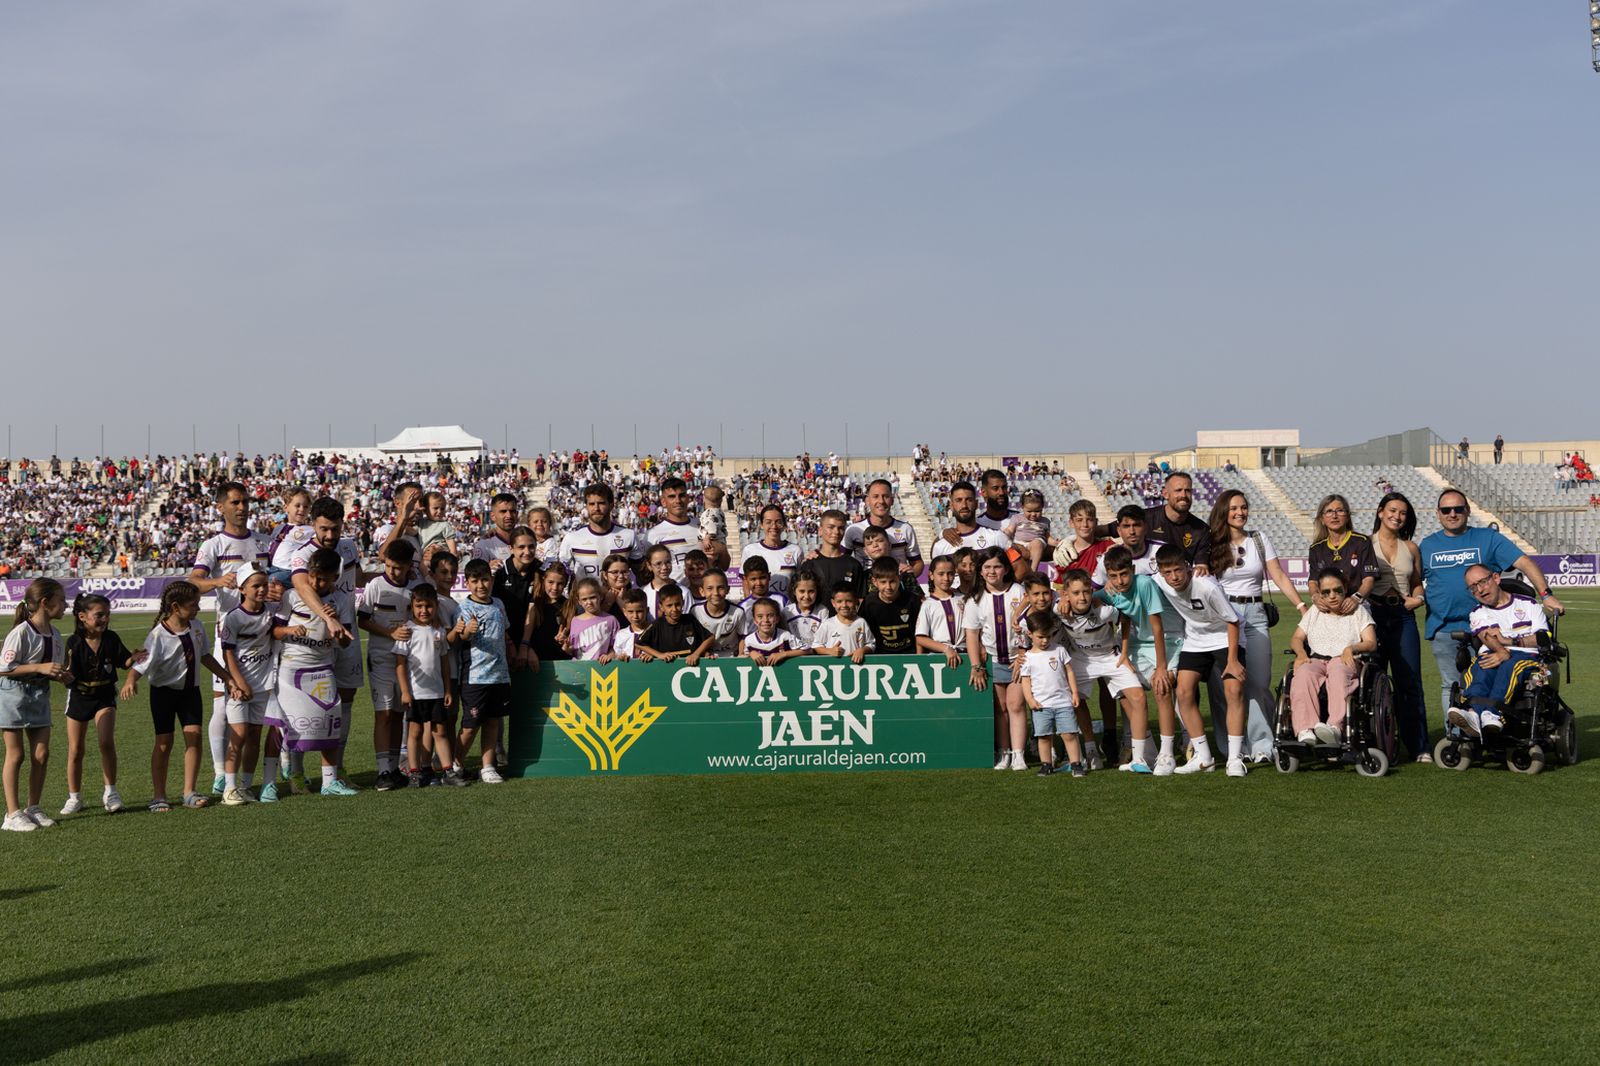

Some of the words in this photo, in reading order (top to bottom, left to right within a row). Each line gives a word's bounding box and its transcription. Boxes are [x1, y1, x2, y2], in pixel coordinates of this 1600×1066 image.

[1435, 552, 1475, 563] Wrangler
[579, 621, 608, 647] NIKE
[671, 666, 788, 706] CAJA
[798, 663, 961, 701] RURAL
[758, 703, 876, 750] JAÉN
[707, 750, 926, 770] www.cajaruraldejaen.com
